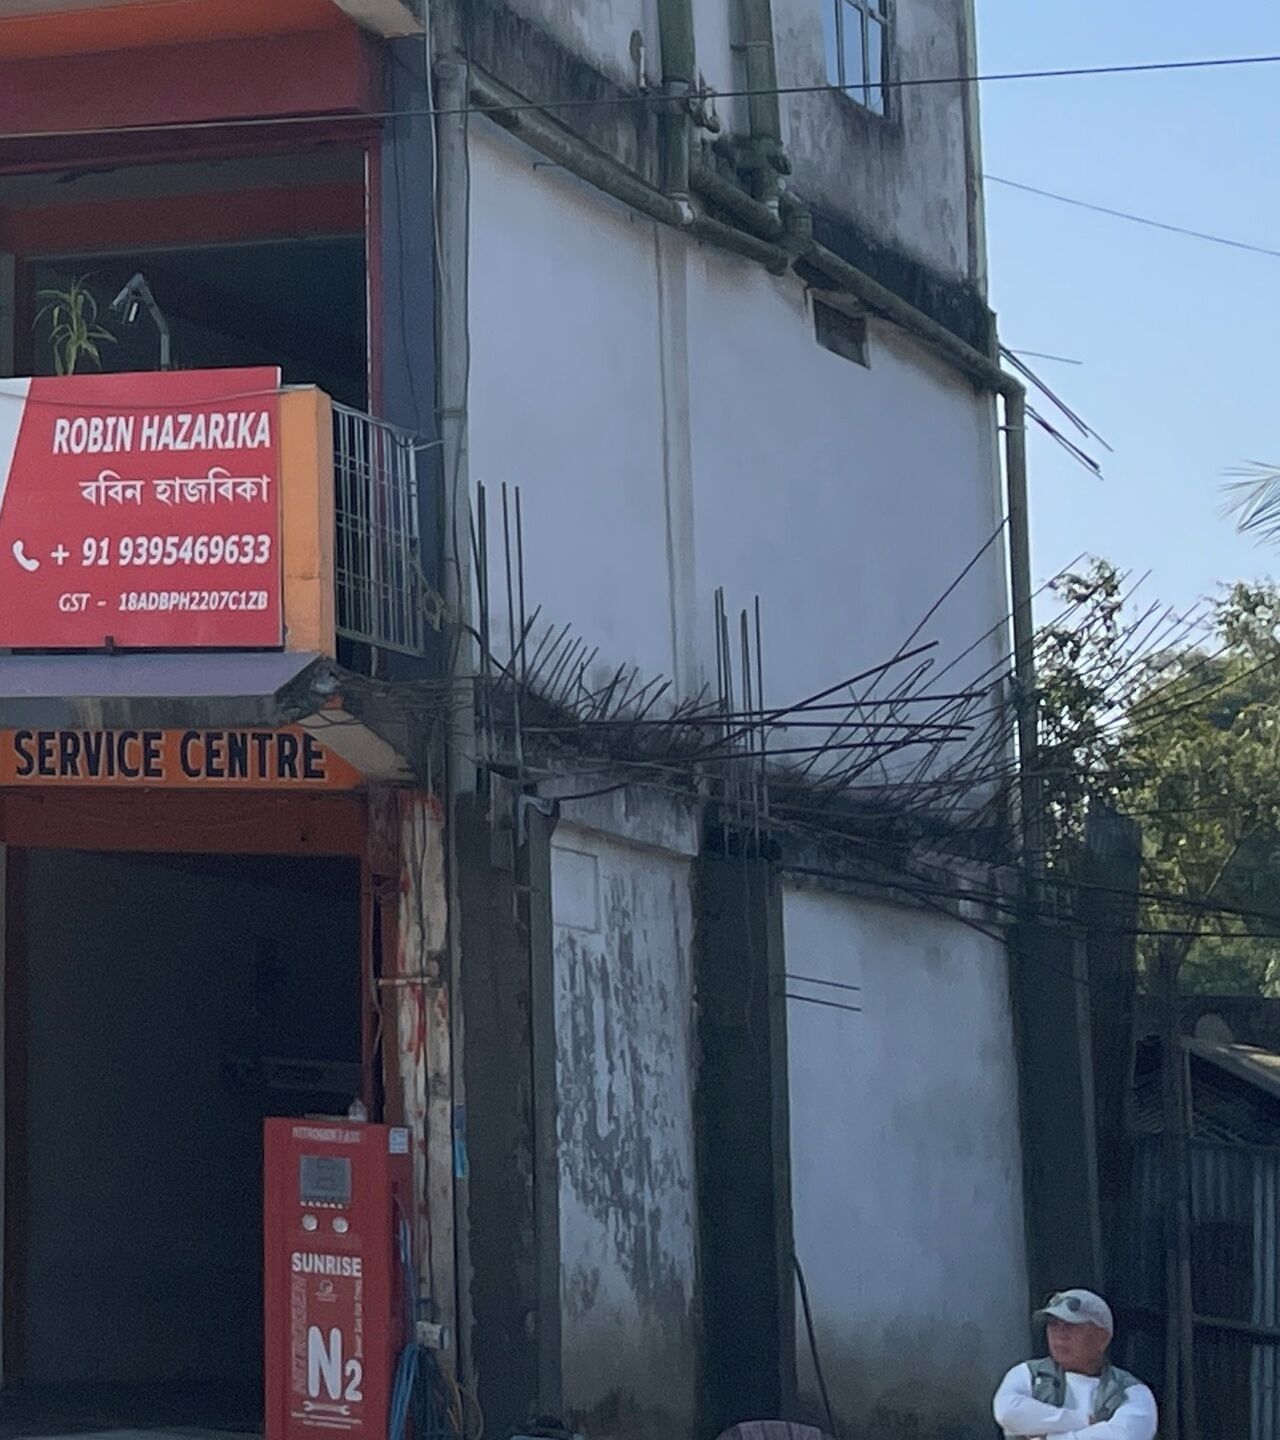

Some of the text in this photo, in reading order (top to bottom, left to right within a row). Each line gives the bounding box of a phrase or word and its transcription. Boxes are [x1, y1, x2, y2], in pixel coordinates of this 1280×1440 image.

[52, 410, 272, 455] ROBIN HAZARIKA
[80, 537, 111, 568] 91
[117, 534, 272, 567] 9395469633
[58, 592, 92, 613] GST
[13, 730, 165, 779] SERVICE
[179, 731, 328, 781] CENTRE
[291, 1251, 363, 1278] SUNRISE
